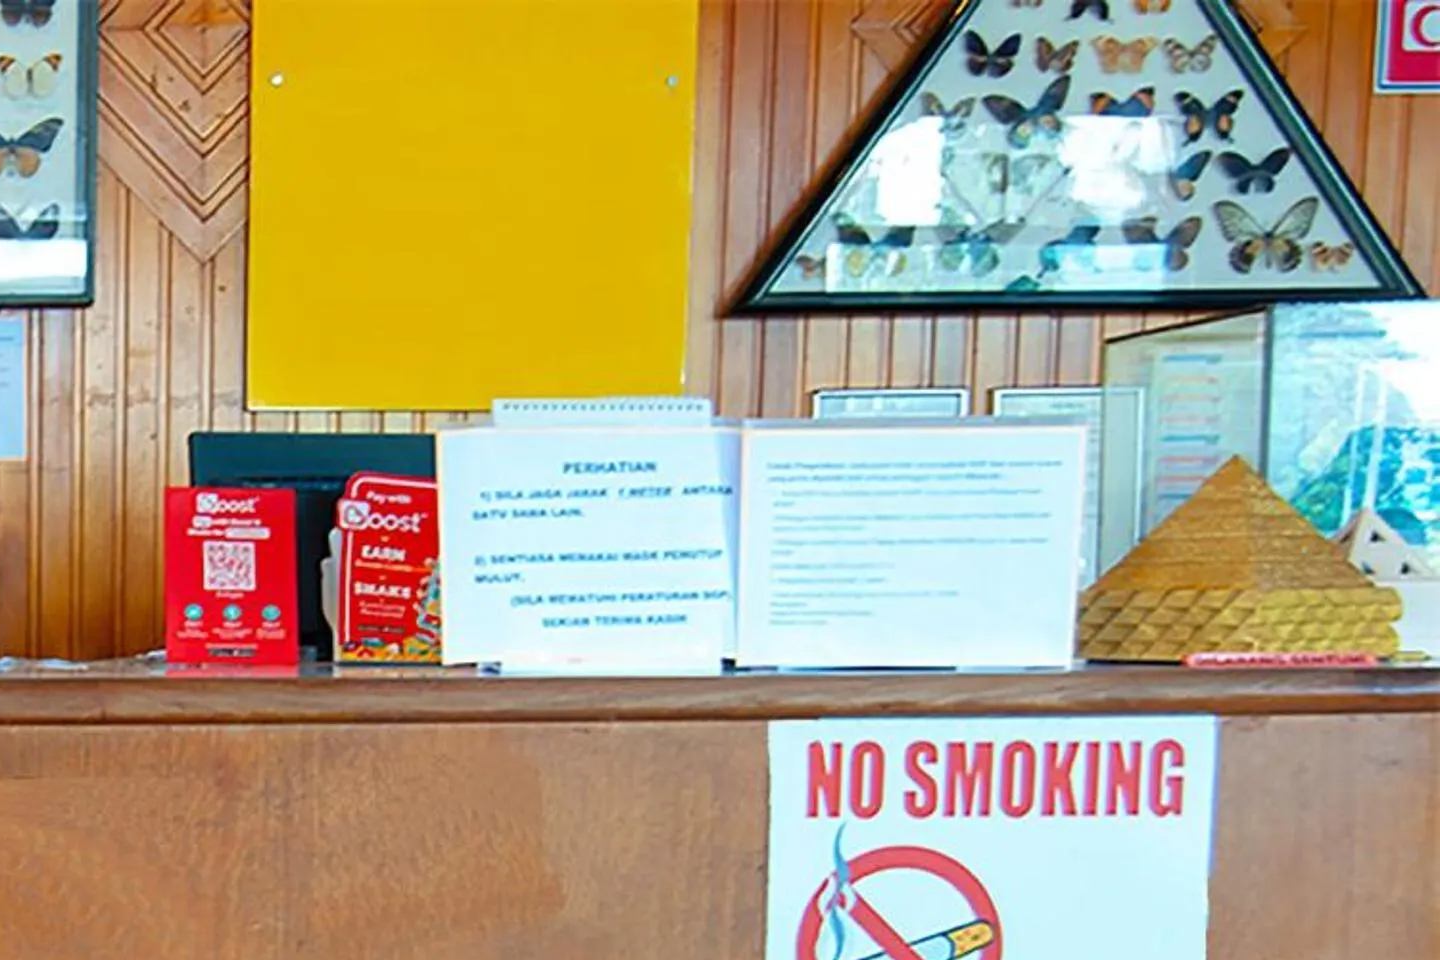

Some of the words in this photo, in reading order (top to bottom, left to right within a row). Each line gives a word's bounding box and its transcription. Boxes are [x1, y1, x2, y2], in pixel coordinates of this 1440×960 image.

[562, 461, 657, 474] PERHATIAN
[338, 499, 421, 532] Boost
[805, 740, 885, 819] NO
[903, 738, 1186, 819] SMOKING
